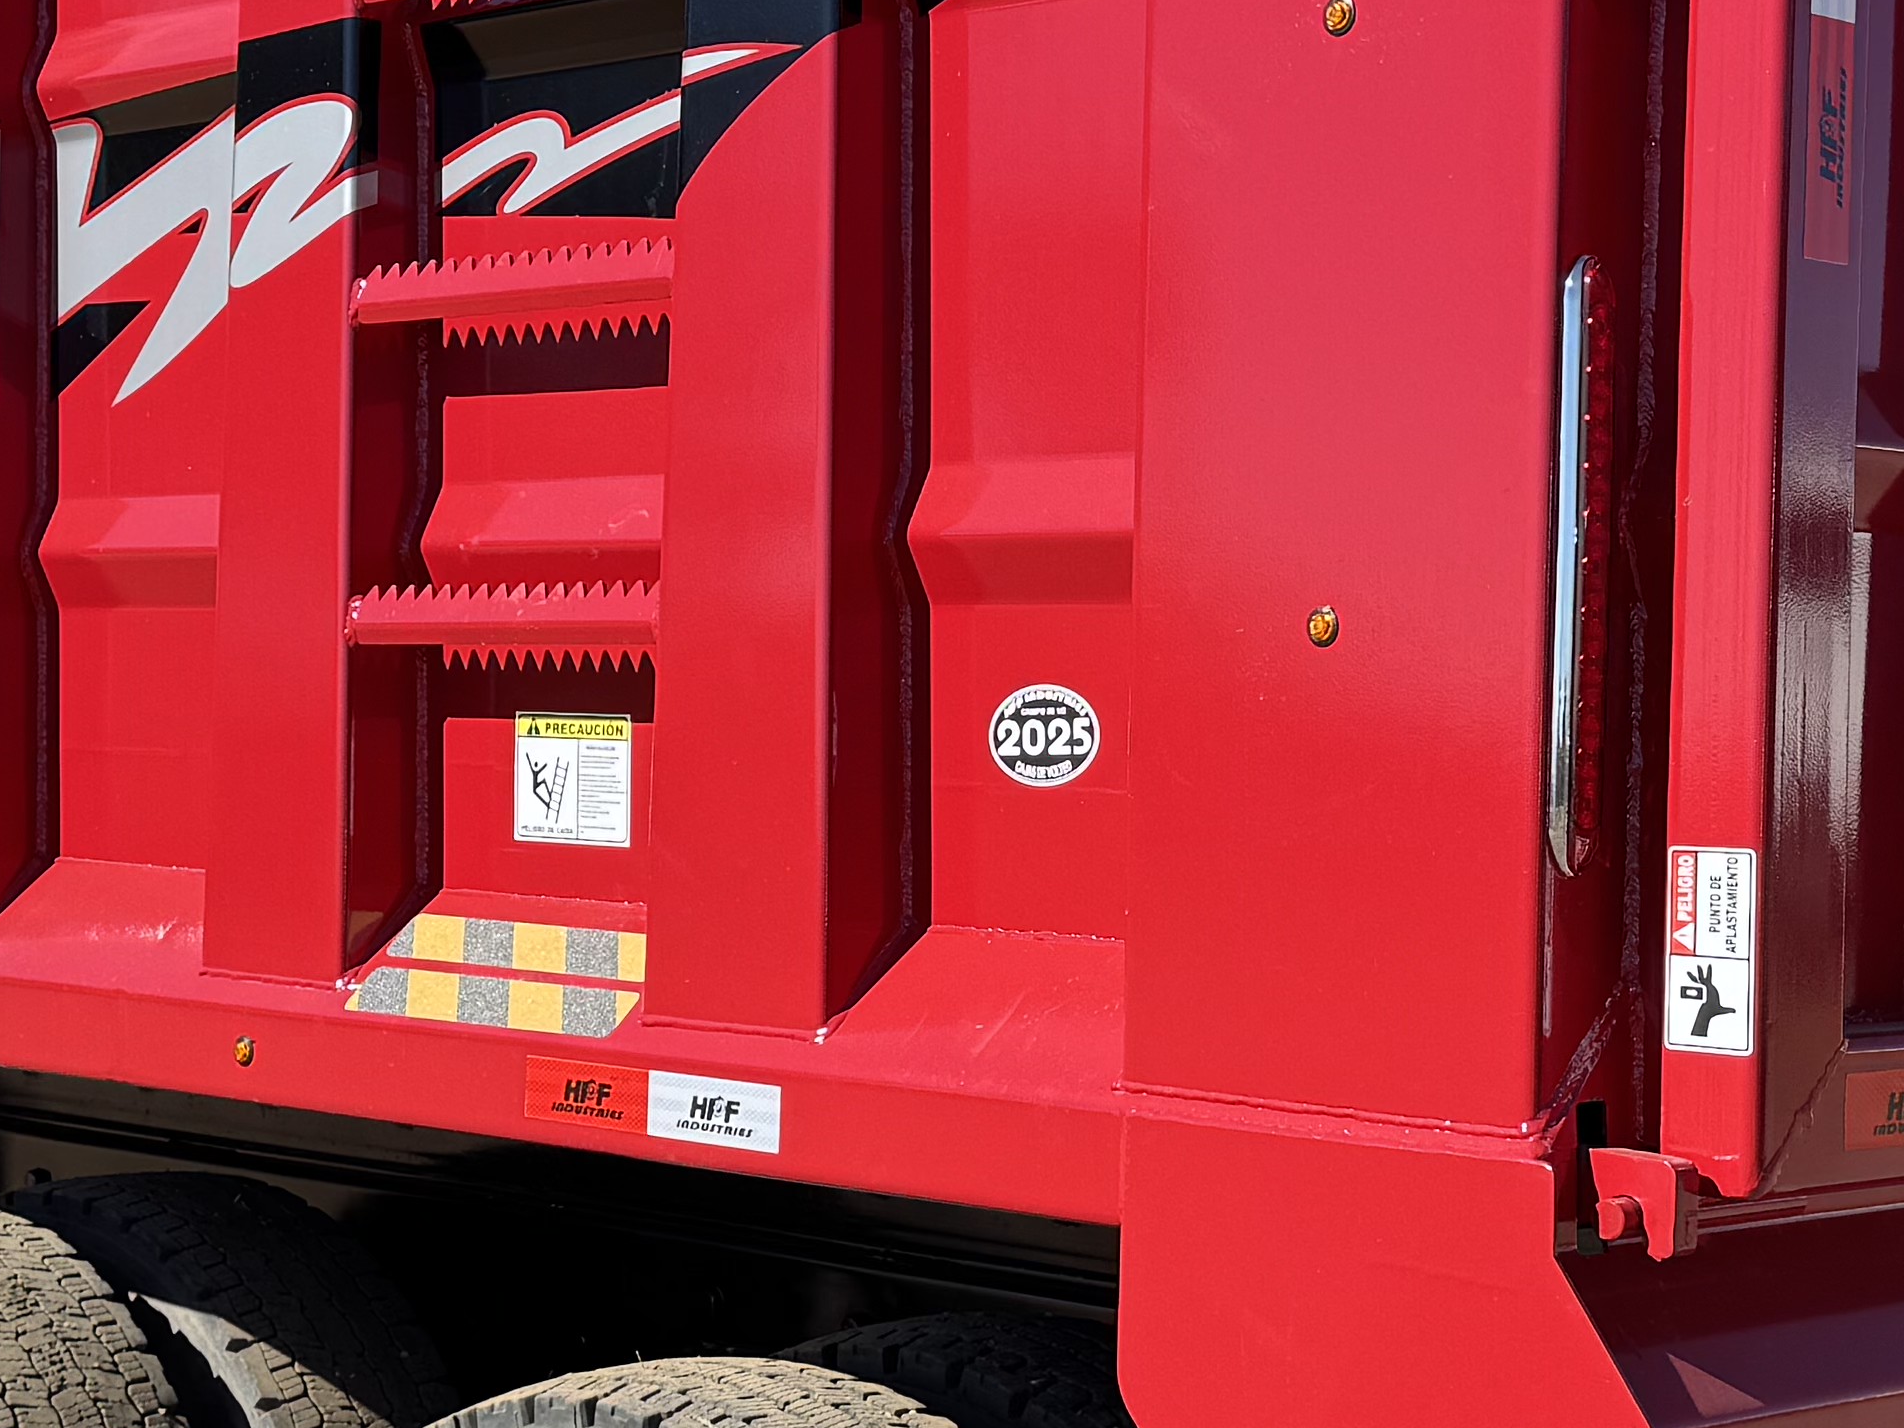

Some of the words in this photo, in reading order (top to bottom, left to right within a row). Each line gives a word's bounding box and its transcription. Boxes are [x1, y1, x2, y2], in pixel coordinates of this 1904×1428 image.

[545, 719, 624, 737] PRECAUCIÓN
[996, 716, 1093, 757] 2025
[1675, 854, 1695, 922] PELIGRO
[1709, 875, 1722, 889] DE
[1708, 892, 1722, 934] PUNTO
[1725, 856, 1739, 954] APLASTAMIENTO
[551, 1101, 625, 1120] INDUSTRIES
[676, 1119, 754, 1139] INDUSTRIES
